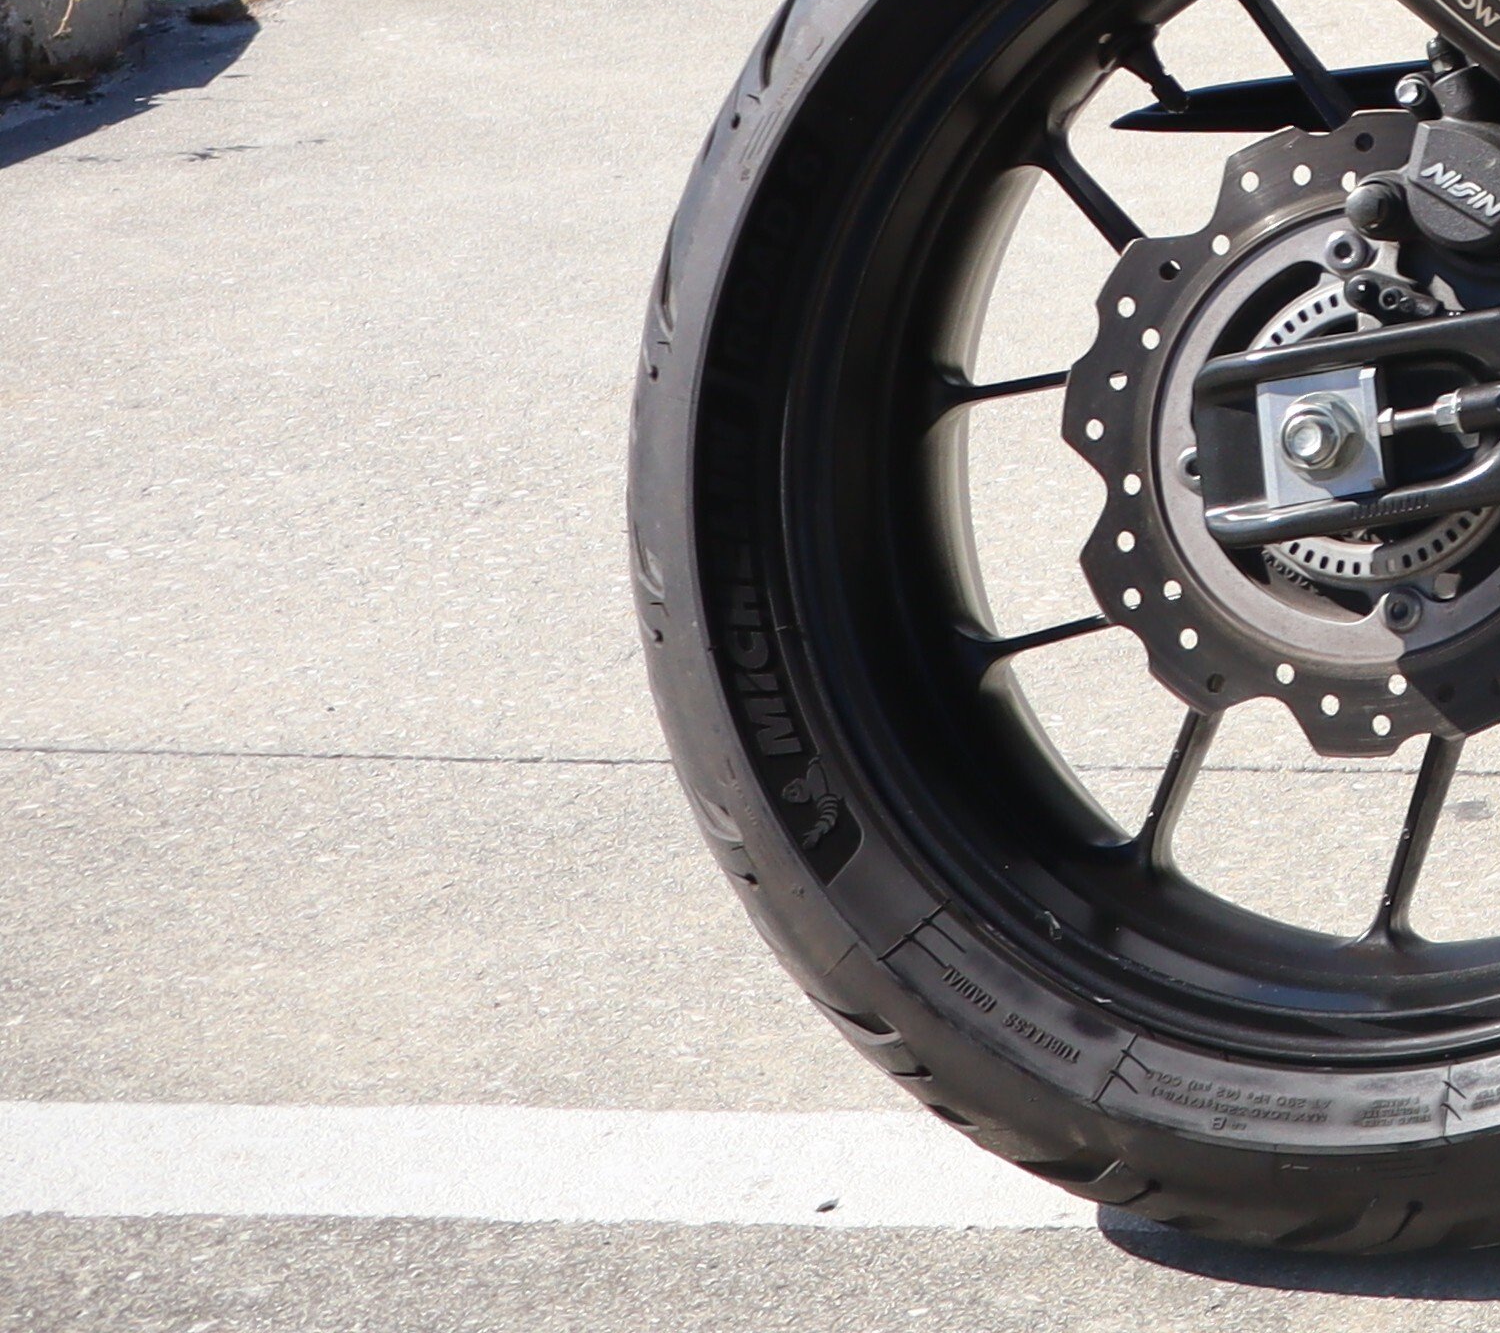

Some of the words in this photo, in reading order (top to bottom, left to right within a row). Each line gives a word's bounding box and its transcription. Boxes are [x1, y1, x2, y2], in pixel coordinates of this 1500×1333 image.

[710, 406, 803, 761] MICHELIN
[940, 965, 997, 1014] RADIAL
[1000, 1009, 1080, 1067] TUBELESS
